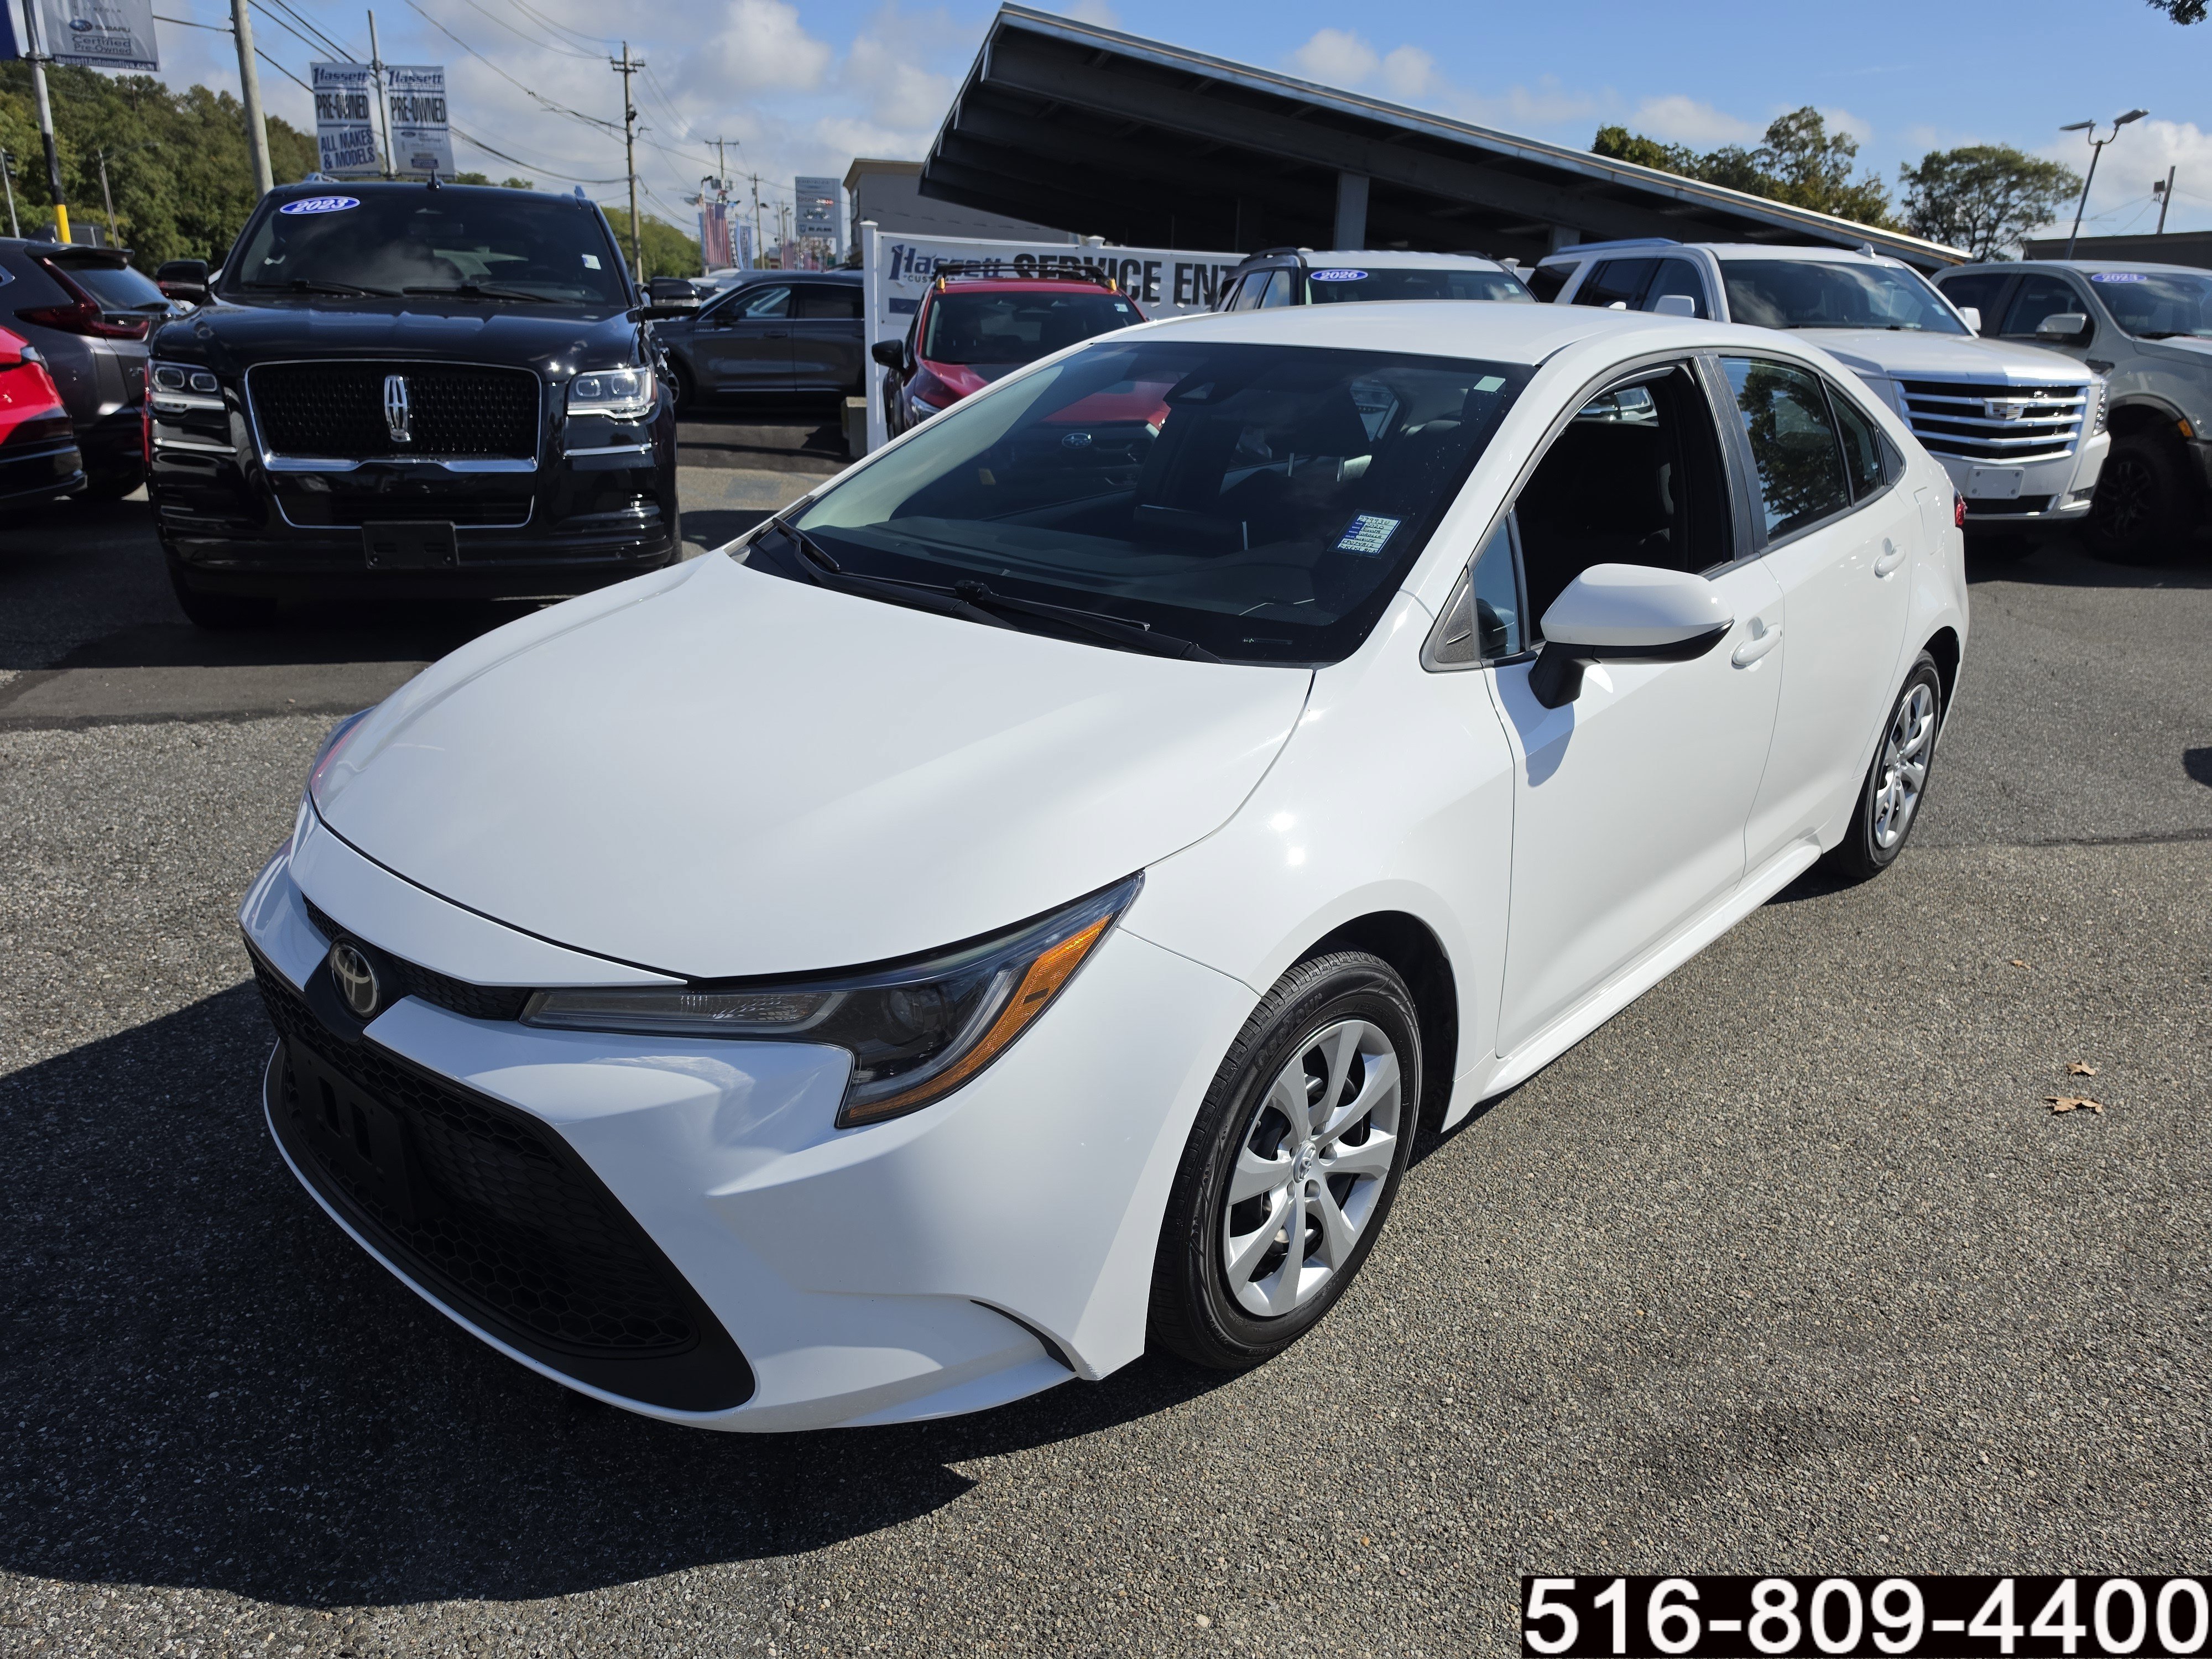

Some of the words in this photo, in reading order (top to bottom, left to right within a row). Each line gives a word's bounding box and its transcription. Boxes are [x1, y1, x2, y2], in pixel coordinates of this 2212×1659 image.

[313, 67, 368, 84] Hassett
[389, 70, 443, 86] Hassett
[316, 94, 369, 120] PRE-OWNED
[390, 96, 446, 122] PRE-OWNED
[321, 137, 337, 152] ALL
[340, 128, 373, 149] MAKES
[324, 154, 333, 170] &
[335, 147, 375, 169] MODELS
[291, 199, 348, 213] 2023
[1014, 253, 1162, 302] SERICE
